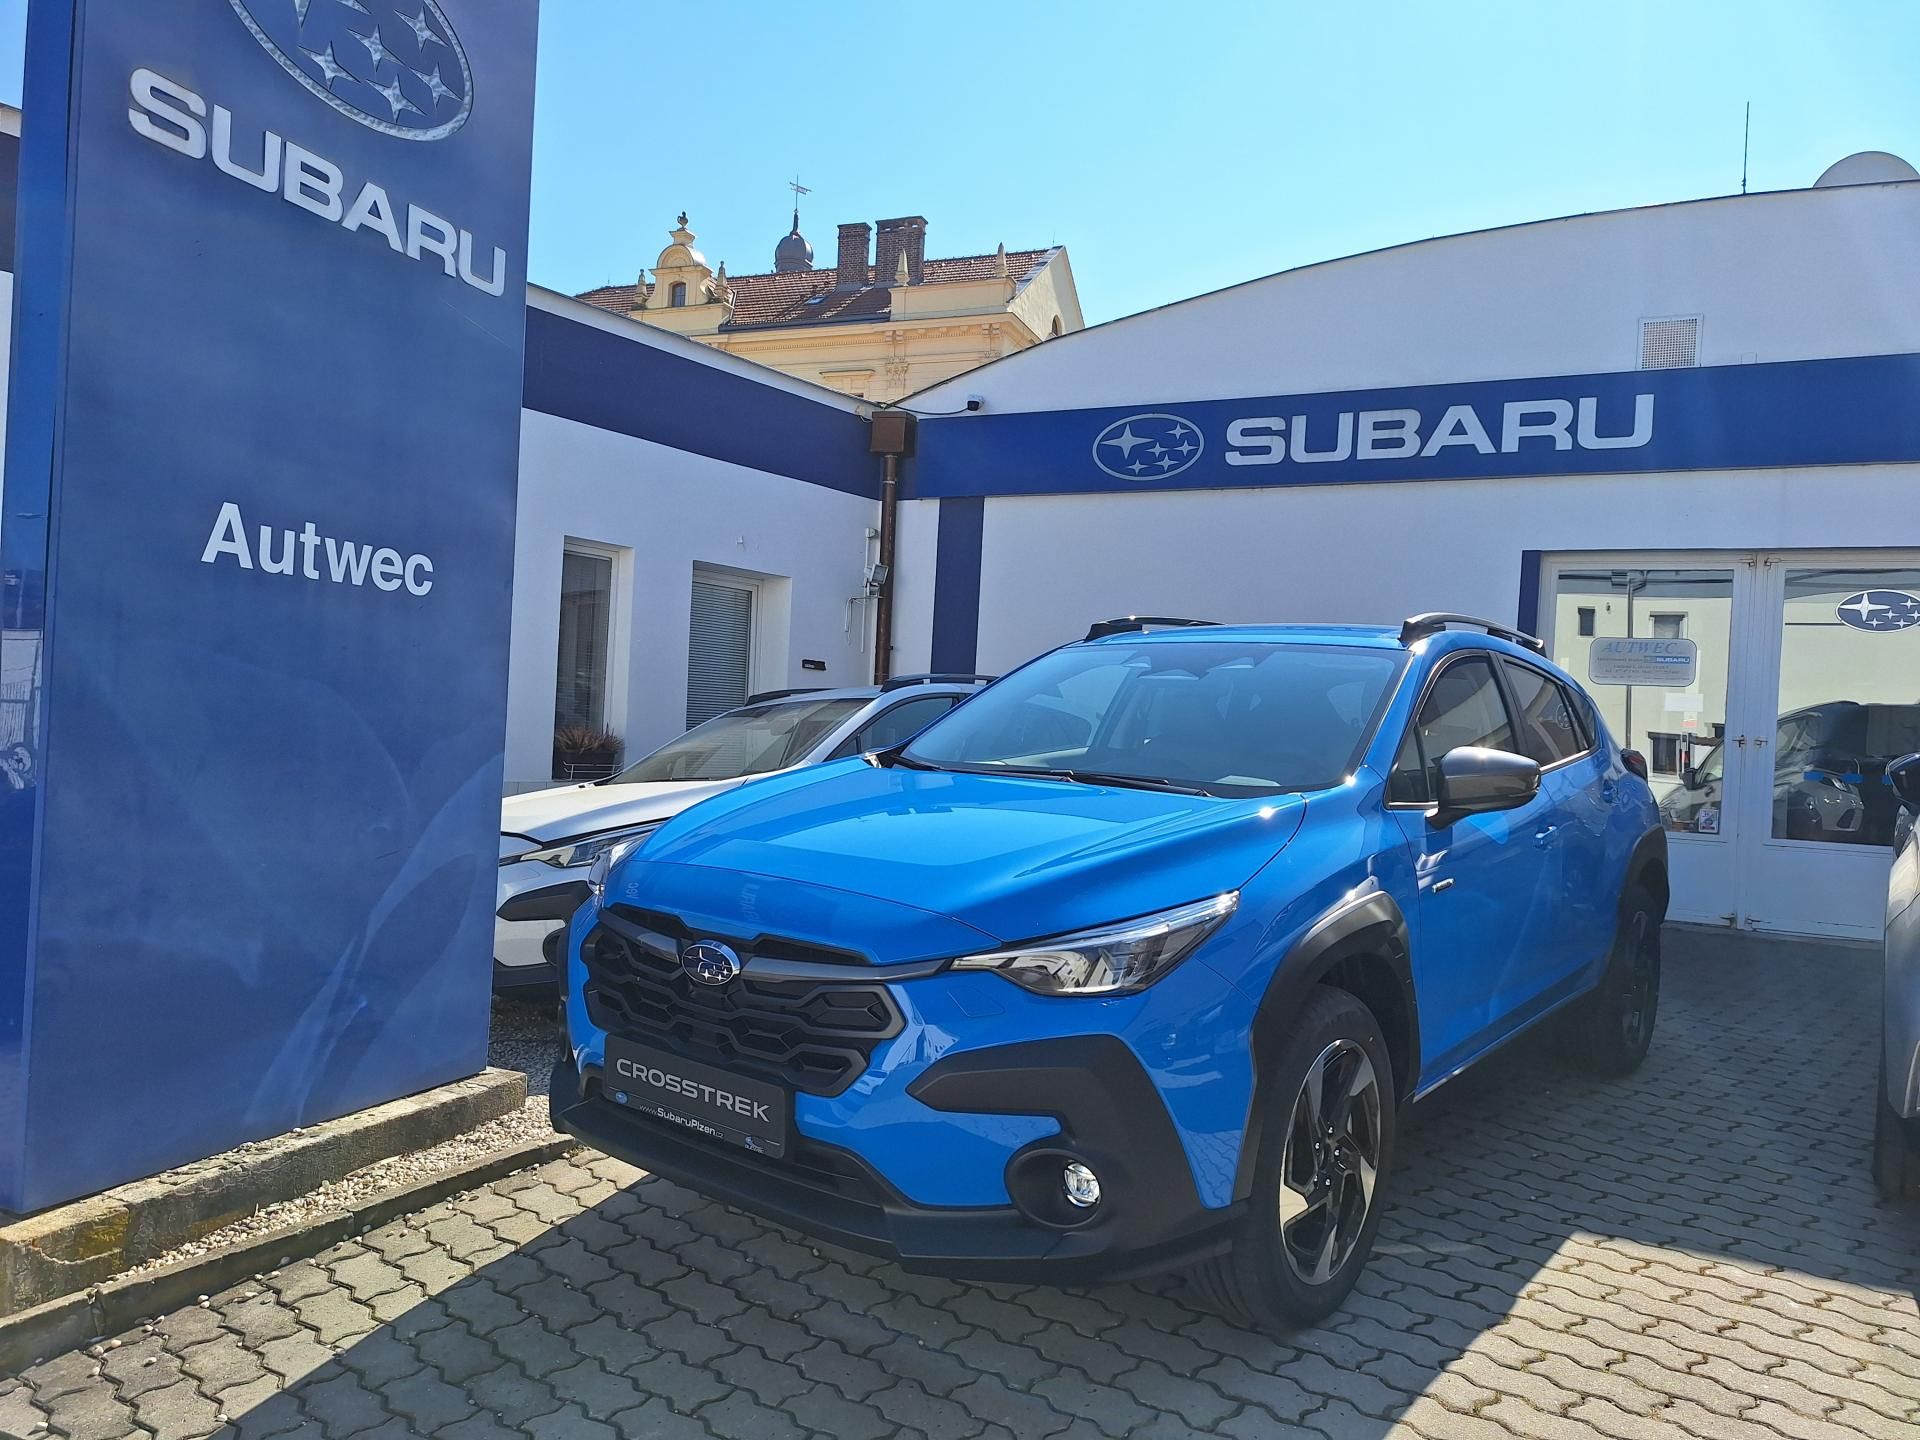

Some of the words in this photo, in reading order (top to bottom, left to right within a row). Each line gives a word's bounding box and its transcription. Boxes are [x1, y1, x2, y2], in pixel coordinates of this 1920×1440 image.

[128, 67, 506, 297] SUBARU
[1224, 393, 1655, 466] SUBARU
[201, 501, 434, 596] Autwec
[1601, 641, 1677, 654] AUTWEC
[616, 1058, 771, 1123] CROSSTREK
